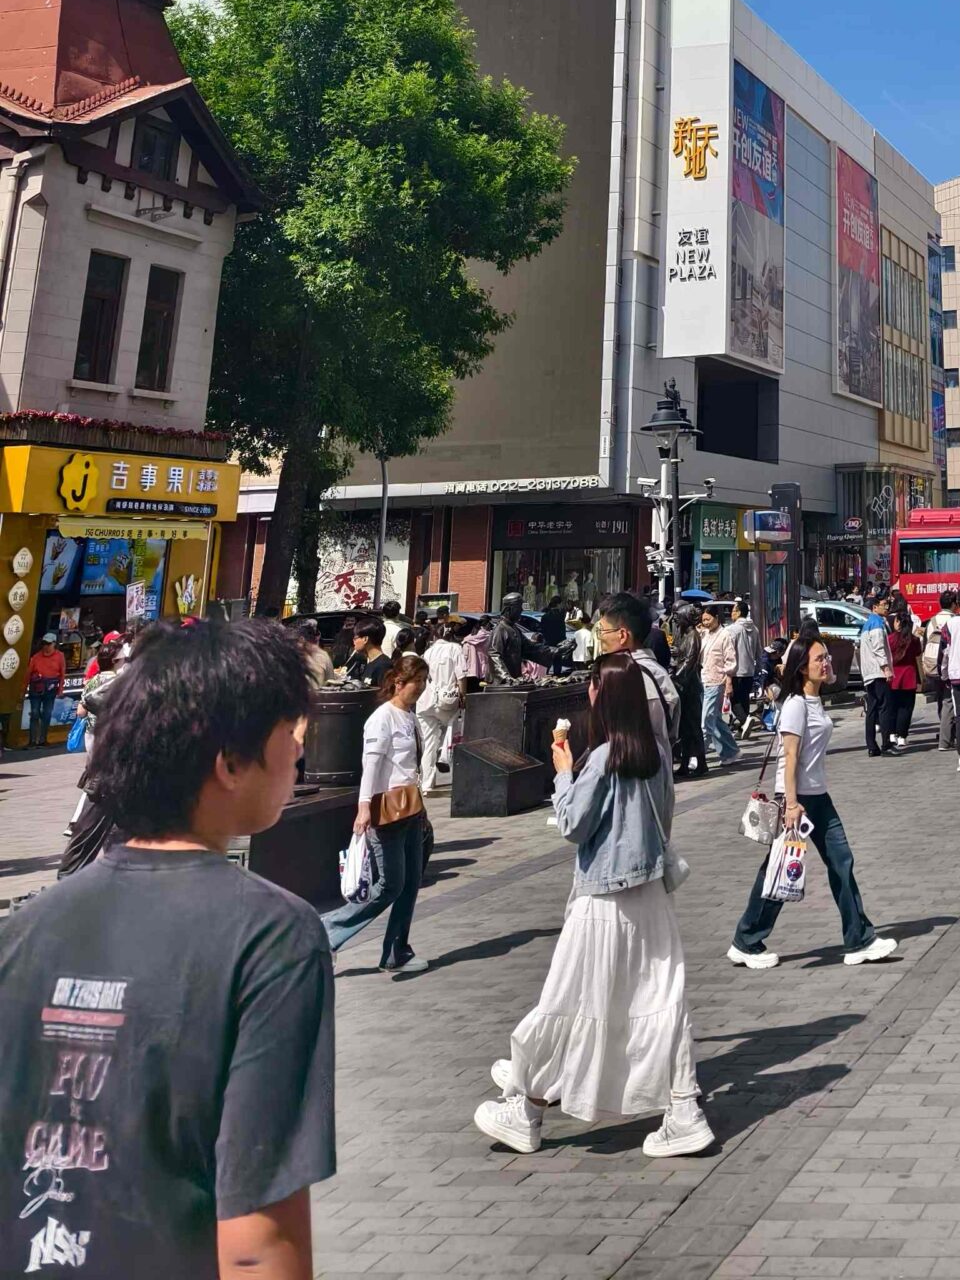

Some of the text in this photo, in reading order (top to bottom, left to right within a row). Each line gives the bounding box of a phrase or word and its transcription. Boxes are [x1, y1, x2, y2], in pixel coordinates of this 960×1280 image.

[678, 227, 710, 247] 友谊
[676, 249, 711, 266] NEW
[669, 265, 718, 283] PLAZA
[111, 460, 185, 494] 吉事果
[490, 476, 599, 494] 022-23137088
[528, 521, 573, 529] 中华老字号
[612, 521, 629, 534] 1911
